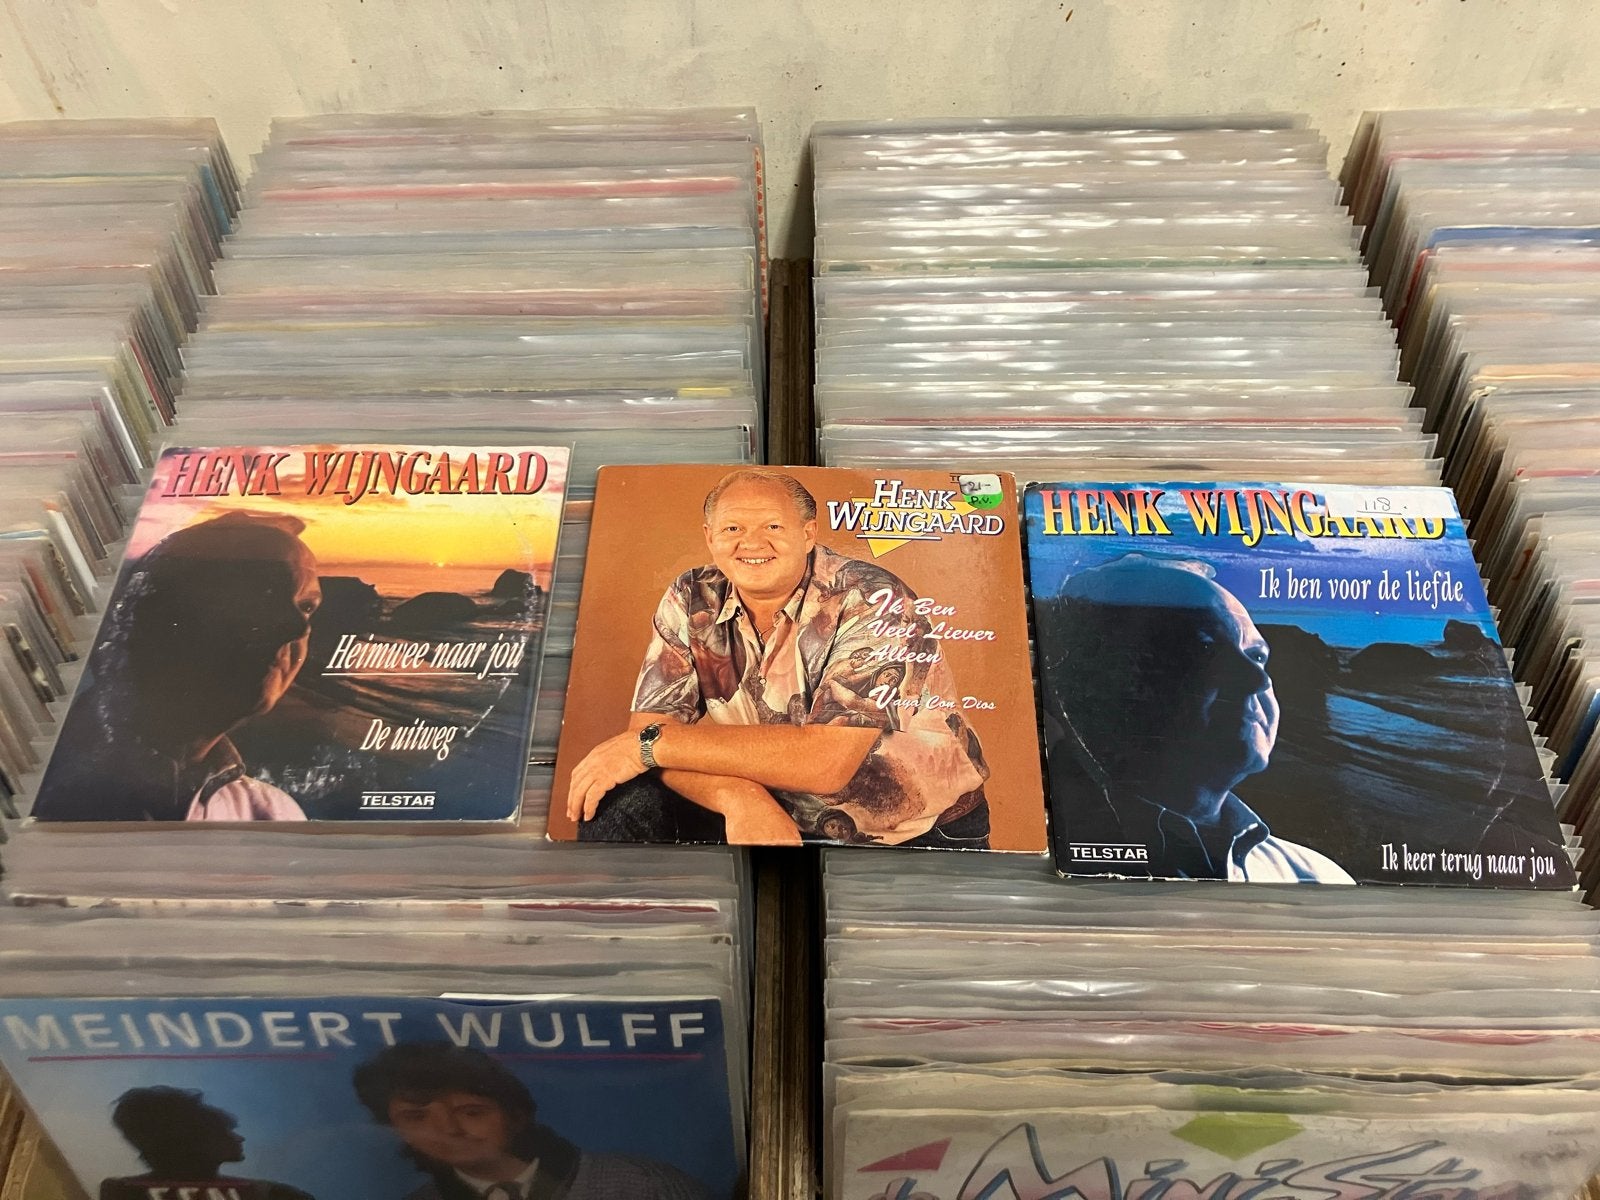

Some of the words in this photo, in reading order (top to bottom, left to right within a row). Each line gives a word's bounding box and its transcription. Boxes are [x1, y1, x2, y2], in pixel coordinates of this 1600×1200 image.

[161, 452, 291, 497] HENK
[303, 451, 549, 506] WIJNGAARD
[870, 479, 957, 510] HENK
[826, 501, 1005, 536] WIJNGAARD
[1040, 488, 1173, 536] HENK
[867, 588, 905, 617] Ik
[913, 597, 957, 616] Ben
[1259, 568, 1281, 599] Ik
[1287, 568, 1322, 600] ben
[1327, 575, 1372, 600] voor
[1378, 570, 1401, 602] de
[1405, 570, 1464, 610] liefde
[867, 619, 917, 638] Veel
[923, 621, 997, 641] Liever
[326, 633, 430, 669] Heimwee
[430, 642, 488, 669] naar
[477, 633, 527, 680] jou
[865, 644, 943, 663] Alleen
[868, 684, 921, 710] Vaya
[925, 695, 956, 709] Con
[962, 695, 997, 710] Dios
[360, 718, 391, 750] De
[390, 718, 458, 761] uitweg
[361, 795, 435, 806] TELSTAR
[1069, 846, 1148, 859] TELSTAR
[1381, 842, 1398, 870] Ik
[1402, 843, 1436, 872] keer
[1440, 848, 1482, 881] terug
[1487, 855, 1526, 875] naar
[1529, 846, 1556, 882] jou
[3, 1011, 401, 1050] MEINDERT
[436, 1012, 705, 1048] WULFF
